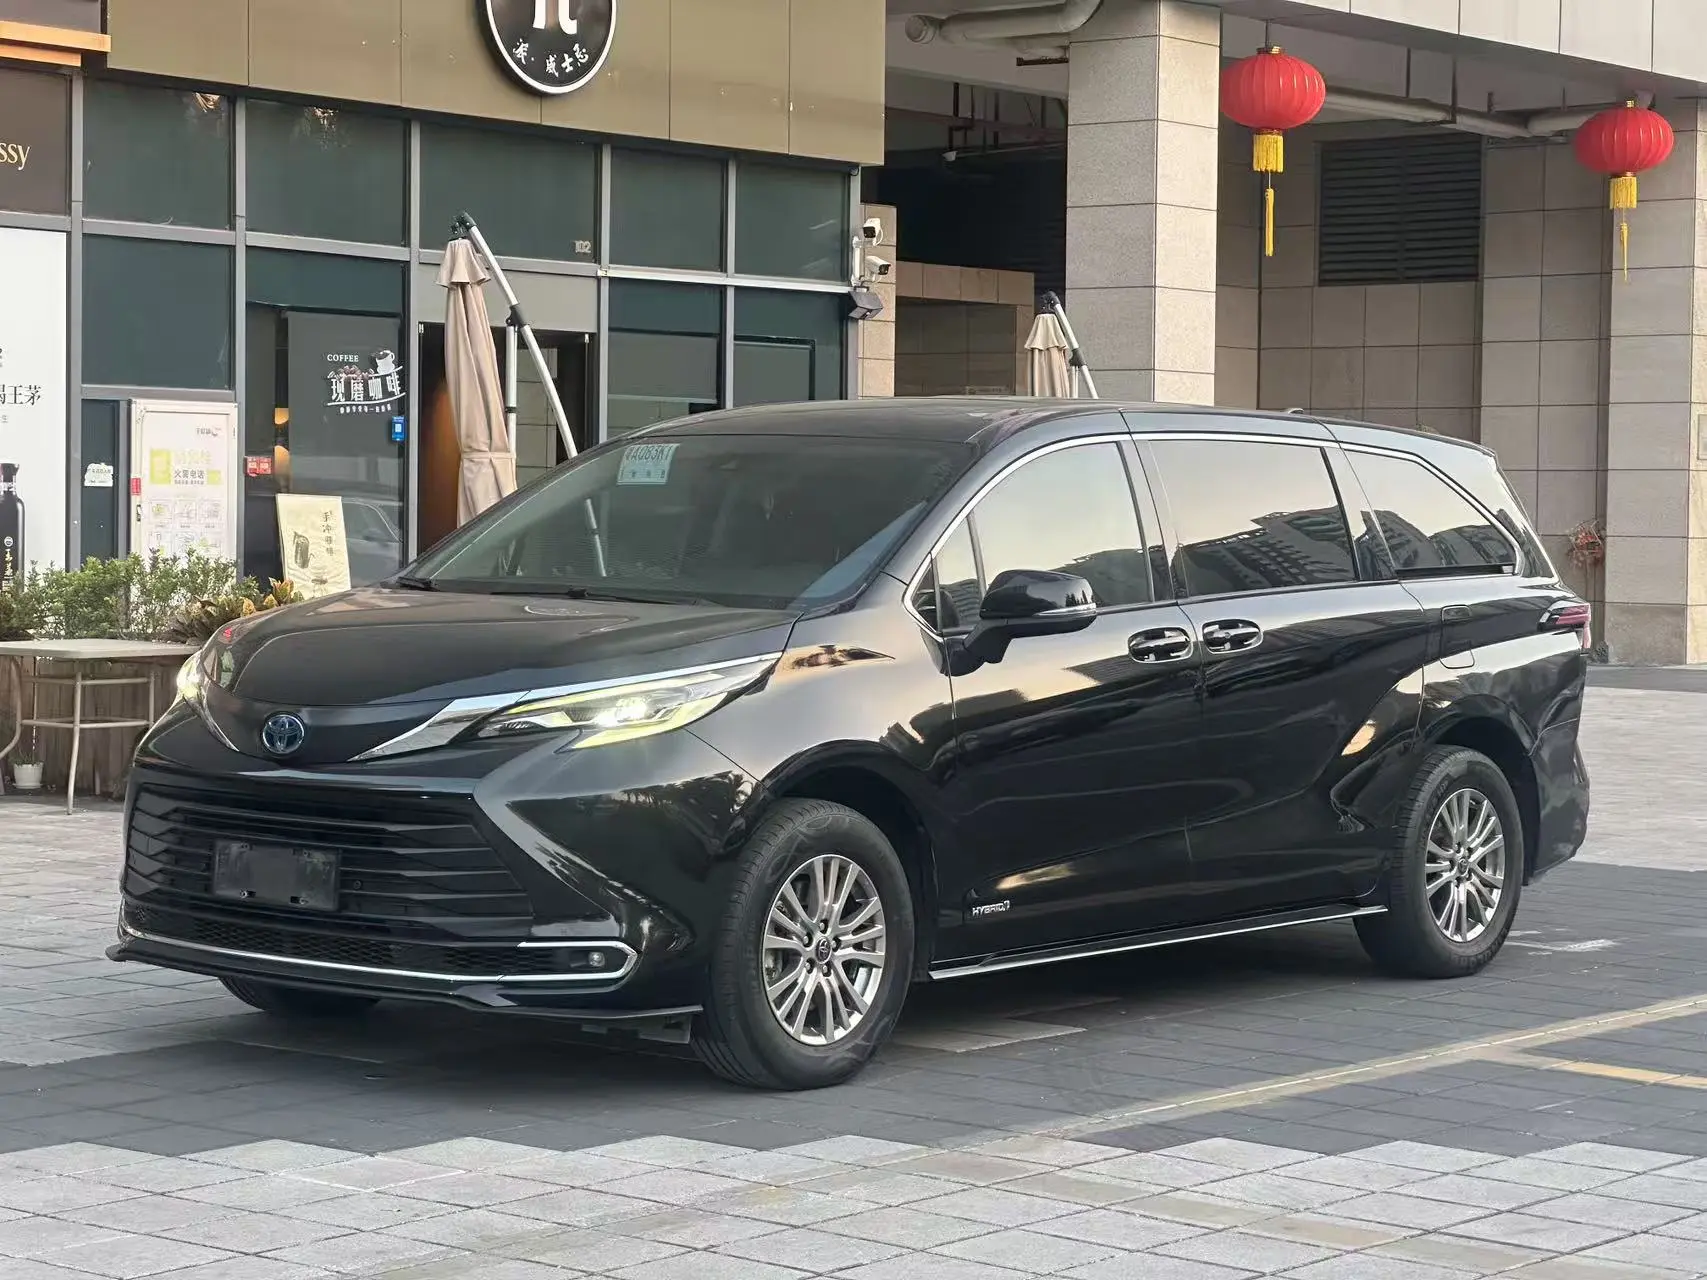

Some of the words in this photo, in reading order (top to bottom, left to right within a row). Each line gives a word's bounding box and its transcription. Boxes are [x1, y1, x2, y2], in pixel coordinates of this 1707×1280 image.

[326, 354, 359, 363] COFFEE
[330, 371, 402, 402] 现磨咖啡
